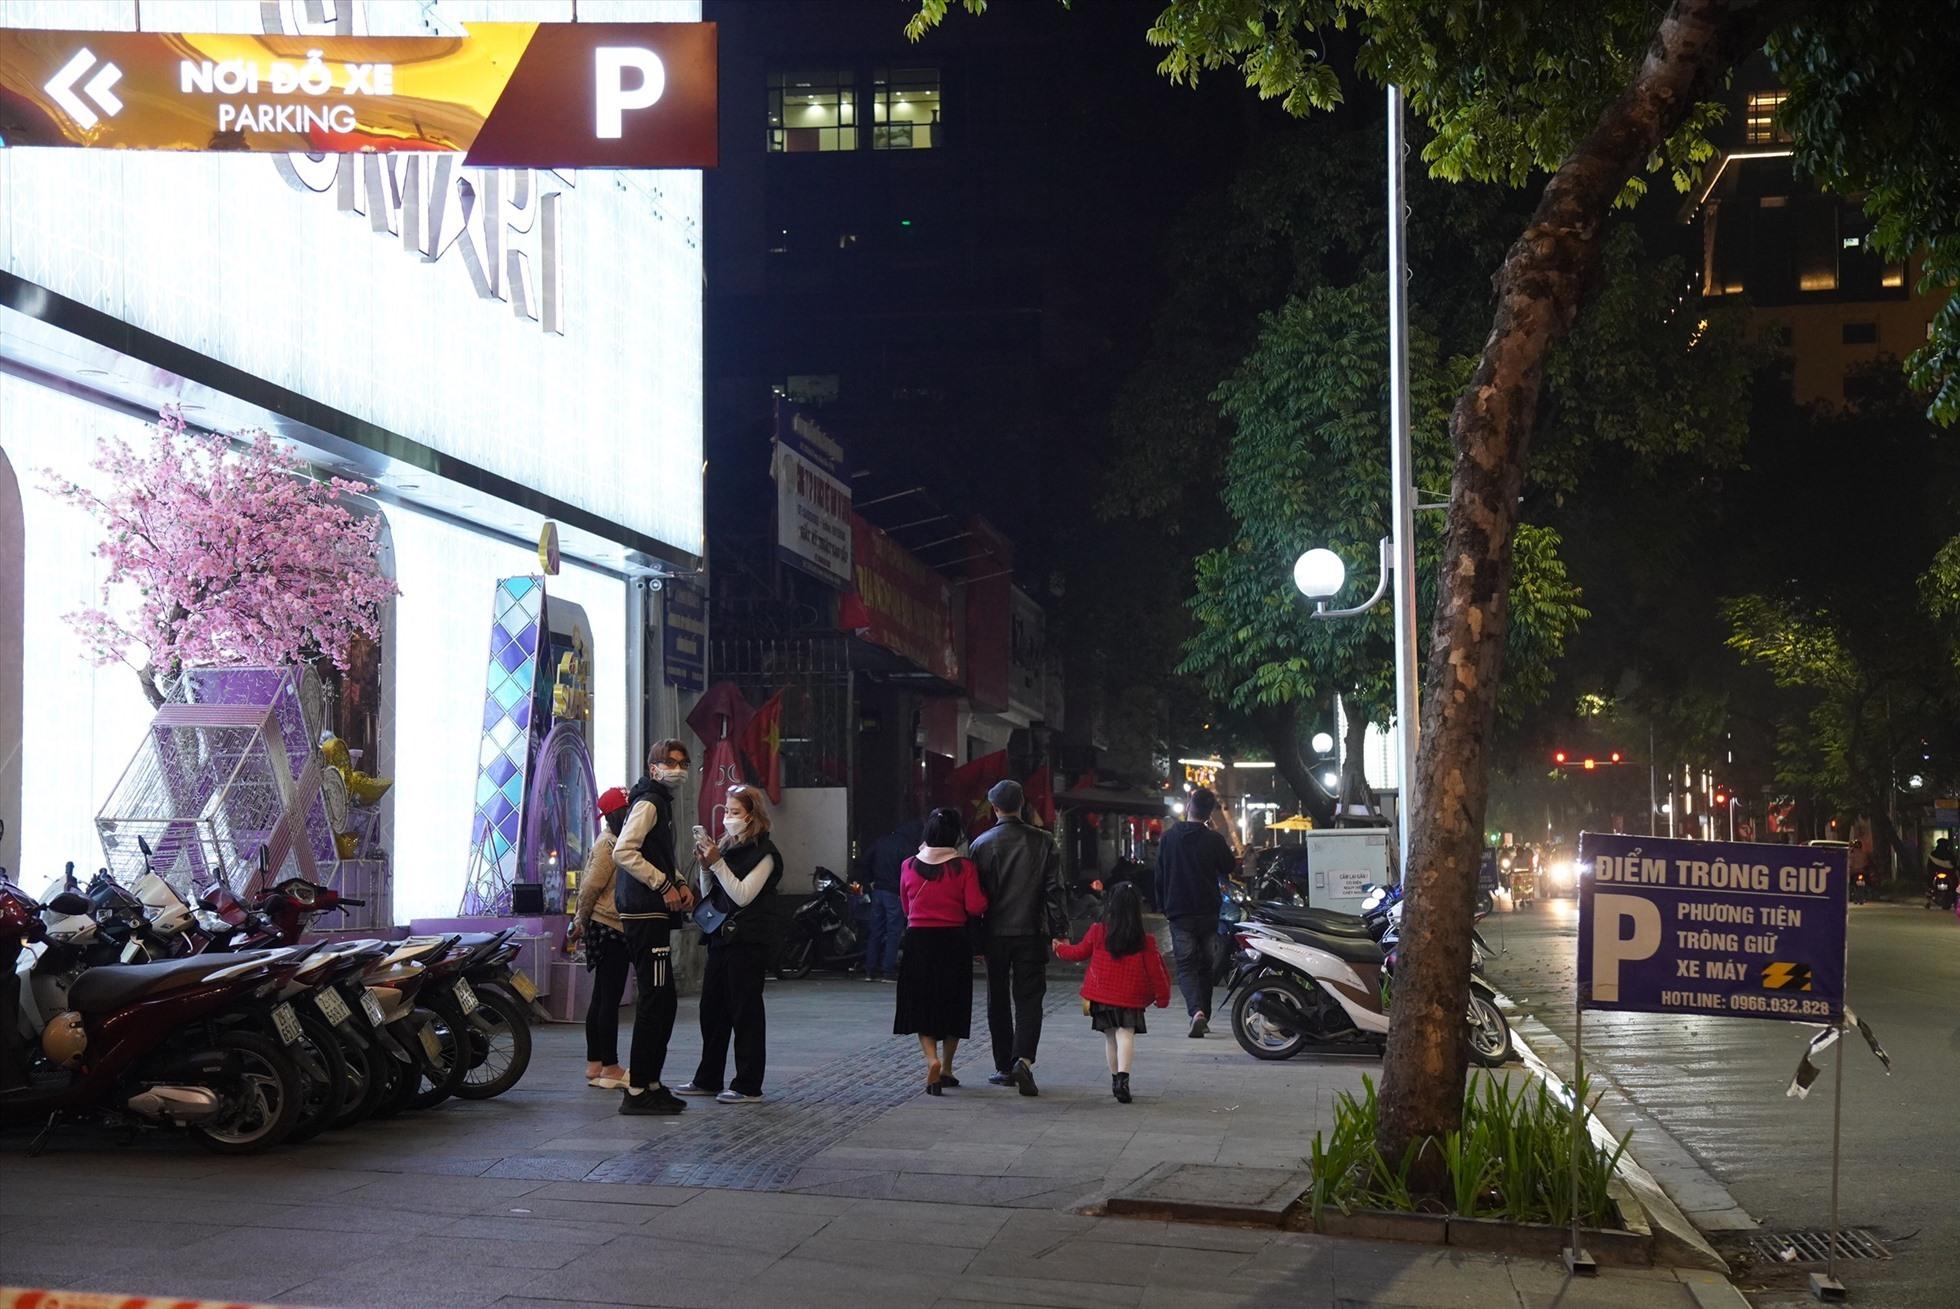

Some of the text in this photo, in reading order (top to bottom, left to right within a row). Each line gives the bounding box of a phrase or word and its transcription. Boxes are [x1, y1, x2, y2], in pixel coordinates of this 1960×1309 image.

[179, 48, 393, 96] NƠI ĐỖ XE
[594, 45, 666, 140] P
[218, 103, 357, 134] PARKING
[1595, 848, 1832, 894] ĐIỂM TRÔNG GIỮ
[1677, 902, 1801, 930] PHƯƠNG TIỆN
[1592, 892, 1662, 1002] P
[1676, 928, 1779, 954] TRÔNG GIỮ
[1676, 959, 1748, 981] XE MÁY
[1661, 990, 1830, 1016] HOTLINE: 0966.032.828
